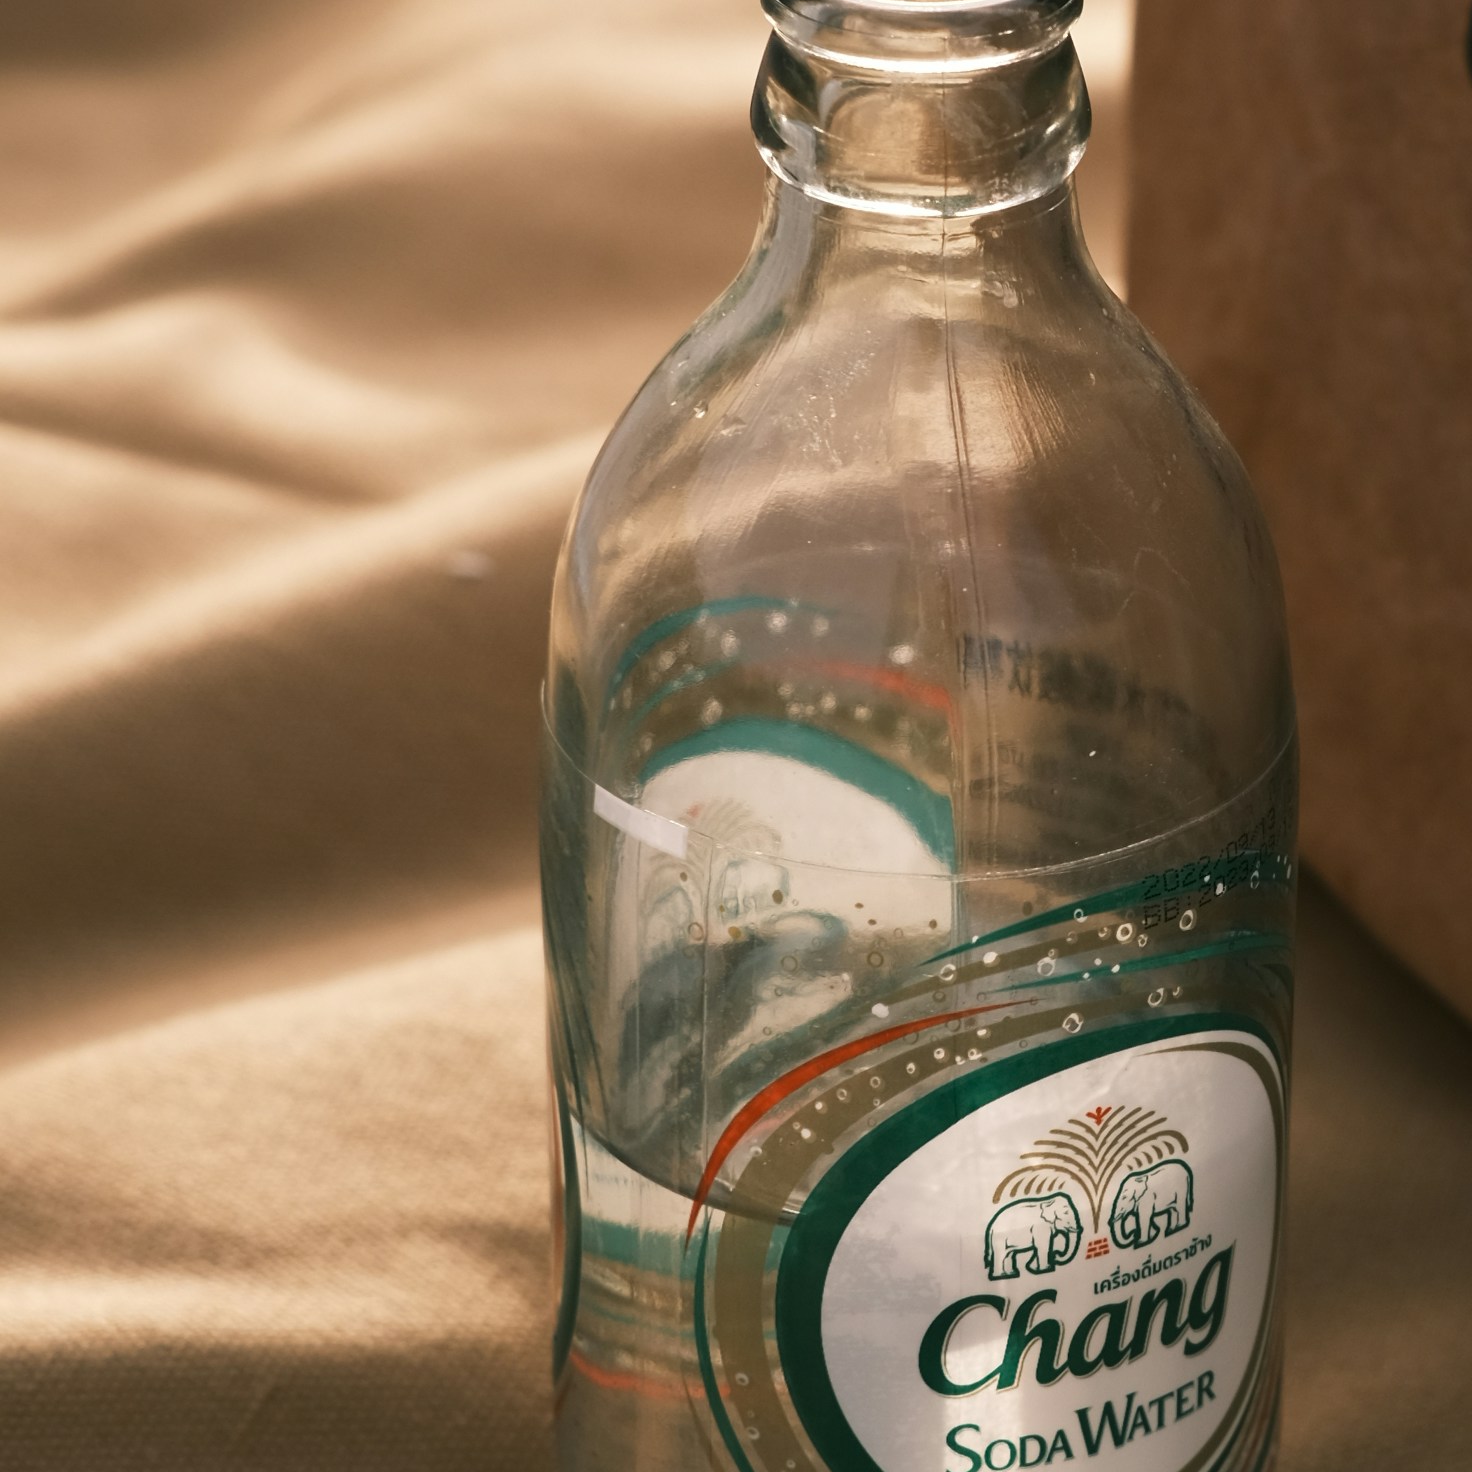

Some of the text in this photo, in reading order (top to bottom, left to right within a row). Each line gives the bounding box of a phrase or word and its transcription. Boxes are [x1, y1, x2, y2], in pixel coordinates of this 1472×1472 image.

[1093, 1234, 1213, 1295] เครื่องดื่มตราช้าง
[918, 1239, 1236, 1399] Chang
[1074, 1369, 1217, 1457] WATER
